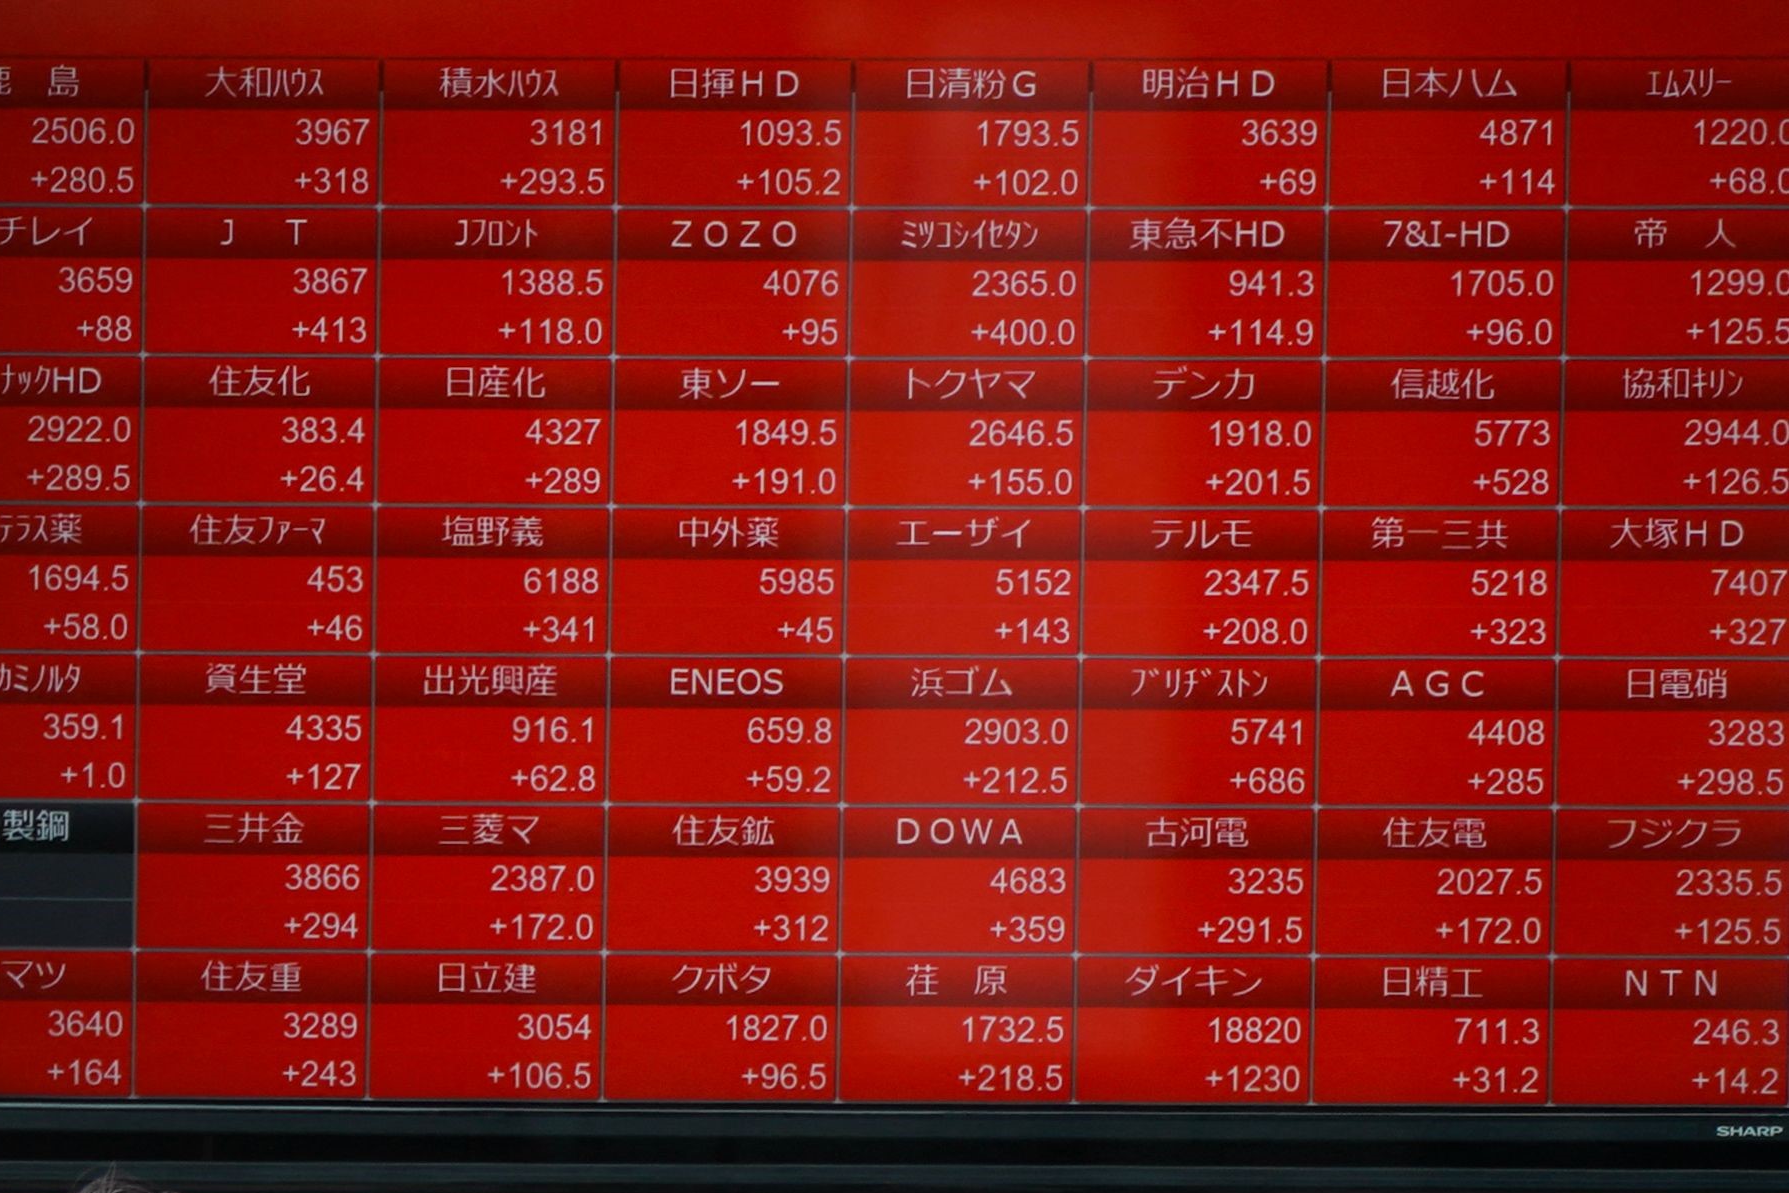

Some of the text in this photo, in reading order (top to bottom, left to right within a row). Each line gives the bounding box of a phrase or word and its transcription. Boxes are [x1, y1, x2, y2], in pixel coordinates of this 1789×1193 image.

[1382, 67, 1518, 99] 日本ハム
[1479, 118, 1553, 146] 4871
[1479, 168, 1556, 195] +114
[1383, 219, 1511, 248] 7&I-HD
[58, 266, 134, 294] 3659
[1228, 269, 1315, 297] 941.3
[1451, 269, 1554, 297] 1705.0
[76, 314, 133, 343] +88
[1208, 318, 1314, 347] +114.9
[1466, 318, 1553, 346] +96.0
[208, 365, 311, 397] 住友化
[907, 367, 1036, 400] トクヤマ
[281, 416, 366, 444] 383.4
[968, 418, 1074, 447] 2646.5
[280, 465, 365, 493] +26.4
[967, 467, 1073, 496] +155.0
[442, 515, 544, 547] 塩野義
[523, 567, 600, 595] 6188
[523, 615, 594, 643] +341
[670, 667, 784, 696] ENEOS
[1627, 667, 1728, 699] 日電硝
[746, 716, 833, 745] 659.8
[1708, 719, 1785, 747] 3283
[746, 765, 832, 794] +59.2
[1677, 767, 1784, 796] +298.5
[1146, 816, 1249, 848] 古河電
[1228, 867, 1304, 895] 3235
[1197, 916, 1303, 944] +291.5
[200, 960, 301, 992] 住友重
[1125, 963, 1262, 997] ダイキン
[283, 1011, 358, 1039] 3289
[1208, 1016, 1302, 1044] 18820
[282, 1059, 357, 1088] +243
[1205, 1064, 1301, 1093] +1230
[1716, 1125, 1784, 1137] SHARP
